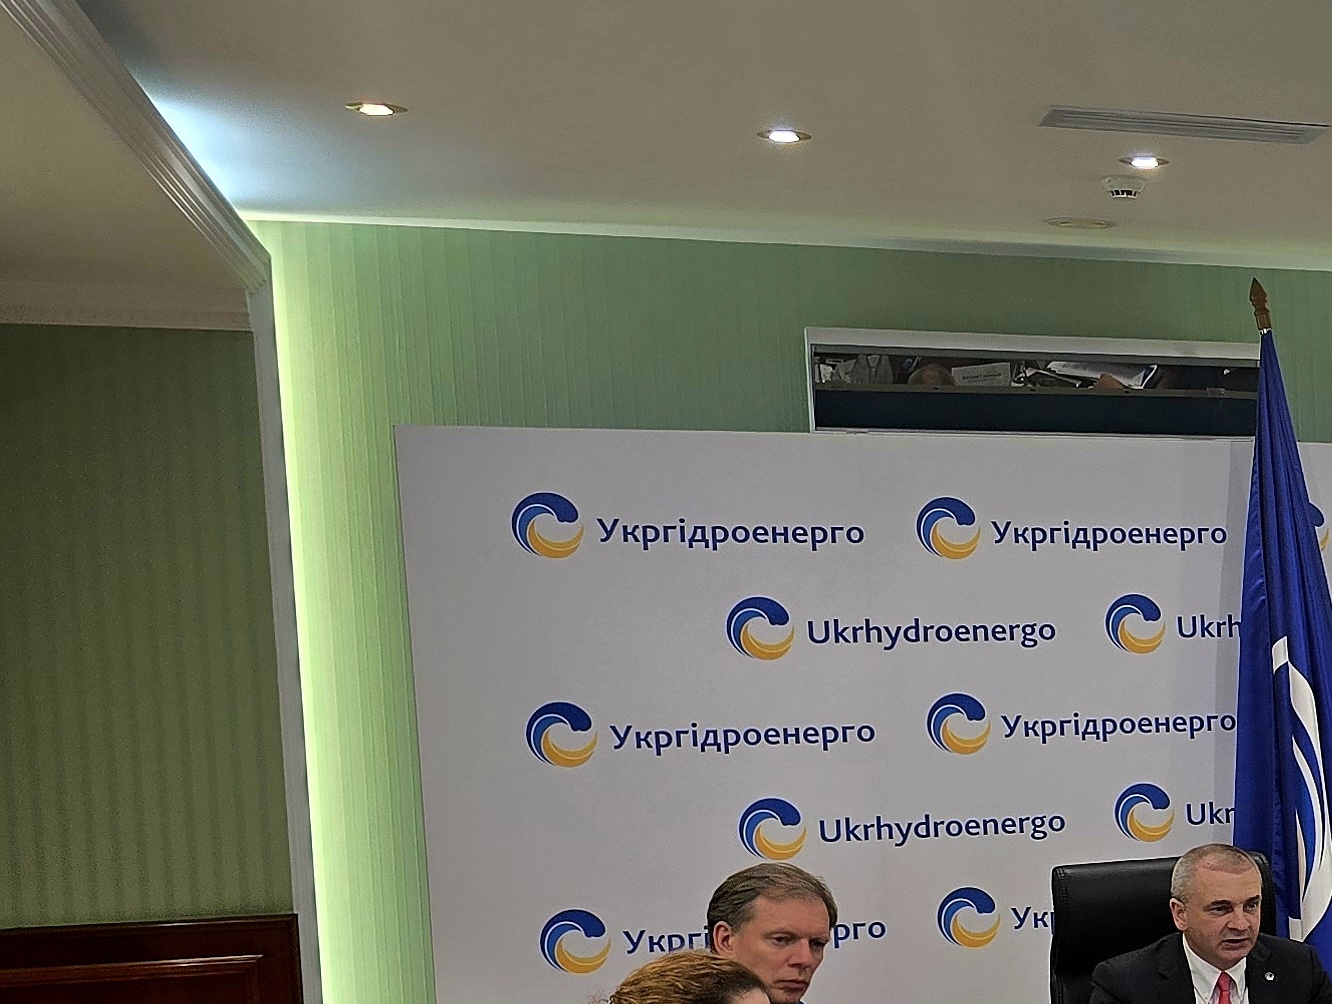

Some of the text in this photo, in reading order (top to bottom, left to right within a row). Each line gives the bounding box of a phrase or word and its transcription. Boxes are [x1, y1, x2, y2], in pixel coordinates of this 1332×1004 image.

[597, 517, 865, 551] Укргідроенерго
[991, 520, 1227, 551] Укргідроенерго
[807, 617, 1056, 650] Ukrhydroenergo
[610, 722, 876, 756] Укргідроенерго
[1001, 712, 1237, 744] Укргідроенерго
[819, 813, 1066, 846] Ukrhydroenergo
